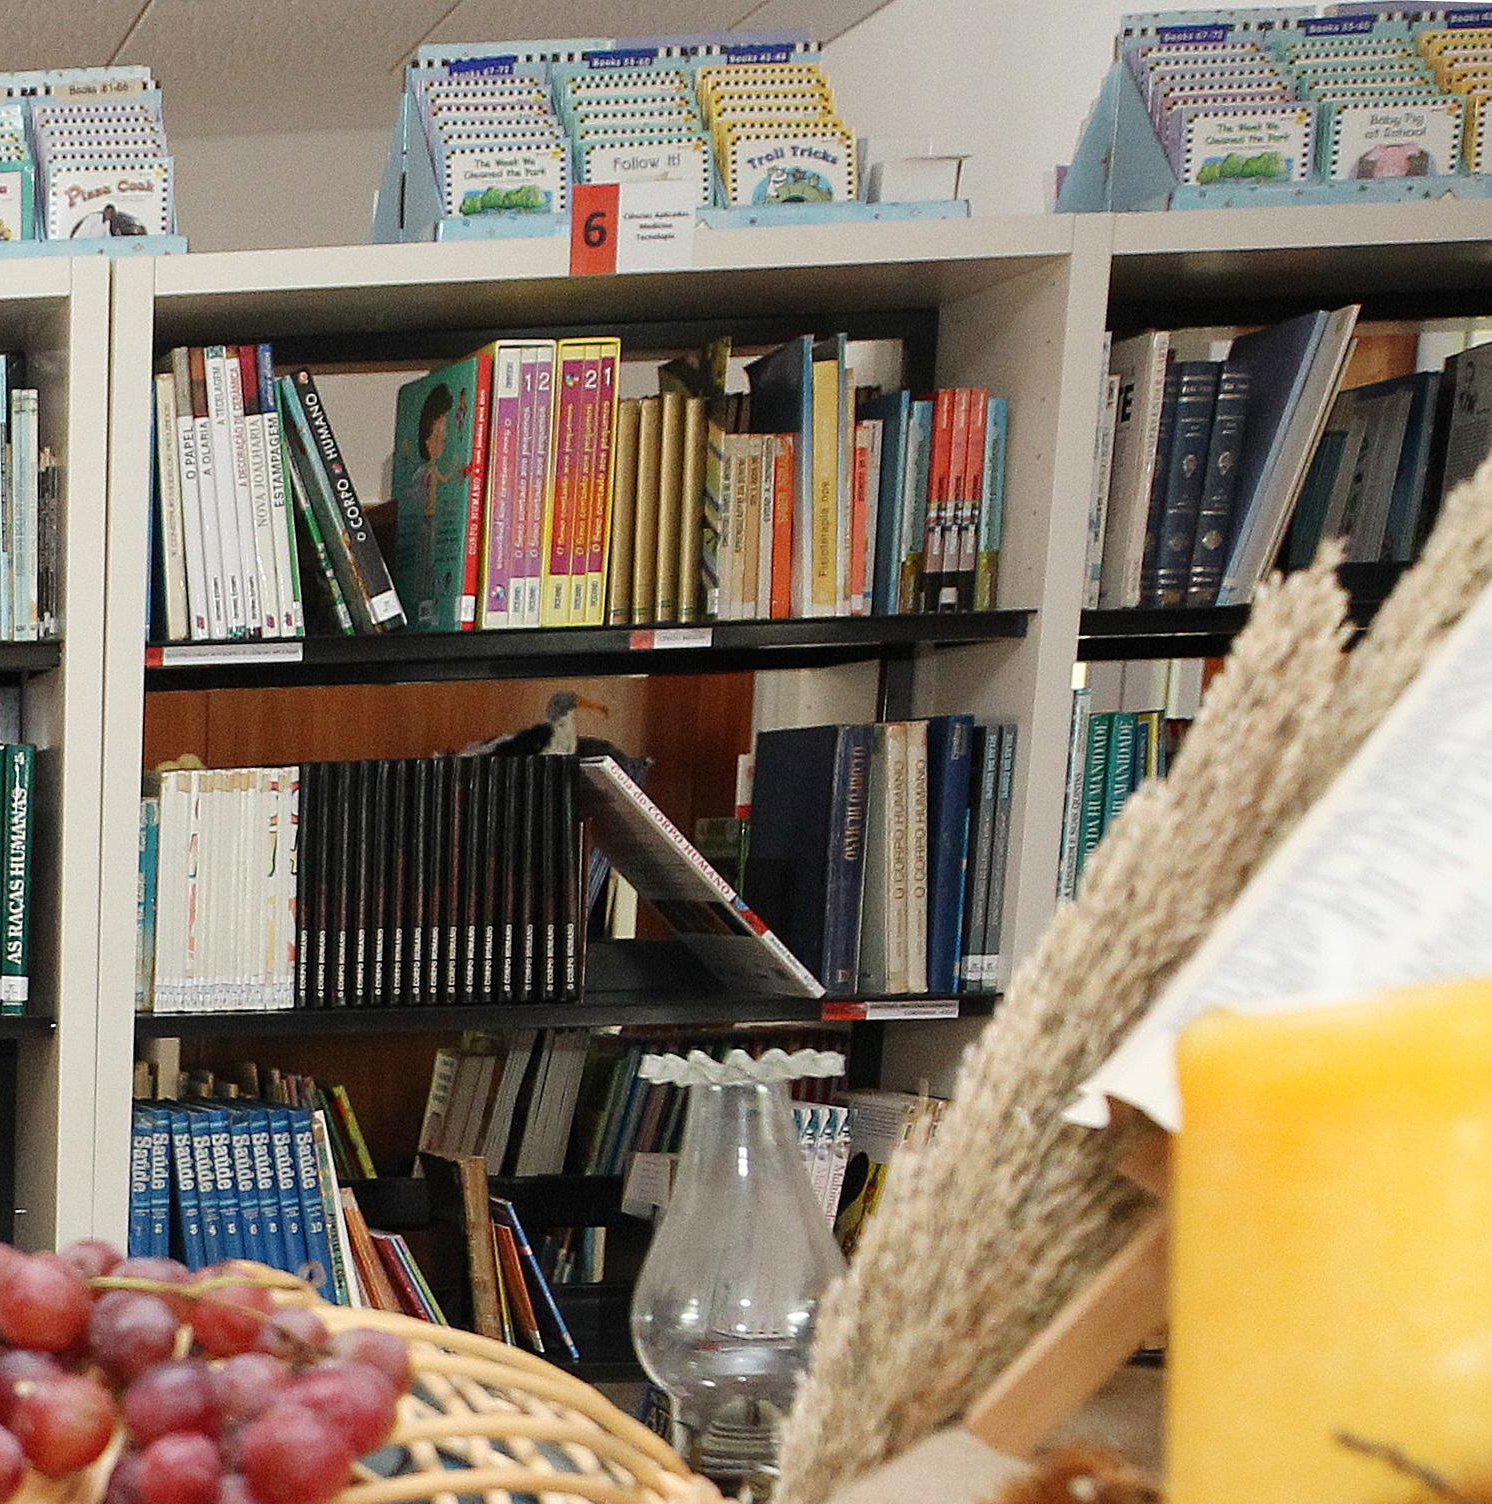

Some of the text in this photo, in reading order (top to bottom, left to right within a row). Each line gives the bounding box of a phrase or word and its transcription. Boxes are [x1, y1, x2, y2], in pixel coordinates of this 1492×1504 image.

[614, 157, 659, 171] Follow
[747, 145, 838, 168] Troll Tricks
[584, 211, 607, 247] 6
[525, 375, 531, 392] 1
[539, 372, 550, 391] 2
[584, 370, 597, 389] 2
[605, 367, 611, 386] 1
[183, 427, 197, 480] O PAPEL
[200, 421, 212, 464] OLARIA
[268, 416, 284, 508] ESTAMPAGEM
[306, 393, 366, 541] O CORPO HUMANO
[249, 418, 269, 528] NOVA JOALHARIA
[1088, 720, 1108, 816] HUMANIDADE
[611, 766, 732, 895] Guia do CORPO HUMANO
[893, 760, 905, 899] O CORPO HUMANO
[915, 759, 926, 899] O CORPO HUMANO
[8, 788, 27, 965] AS RAÇAS HUMANAS
[132, 1136, 152, 1193] Saúde
[152, 1133, 169, 1190] Saúde
[173, 1134, 195, 1191] Saúde
[193, 1135, 215, 1193] Saúde
[211, 1133, 235, 1190] Saúde
[232, 1134, 254, 1192] Saúde
[252, 1132, 274, 1190] Saúde
[274, 1132, 295, 1190] Saúde
[296, 1131, 317, 1190] Saúde
[311, 1222, 323, 1233] 10
